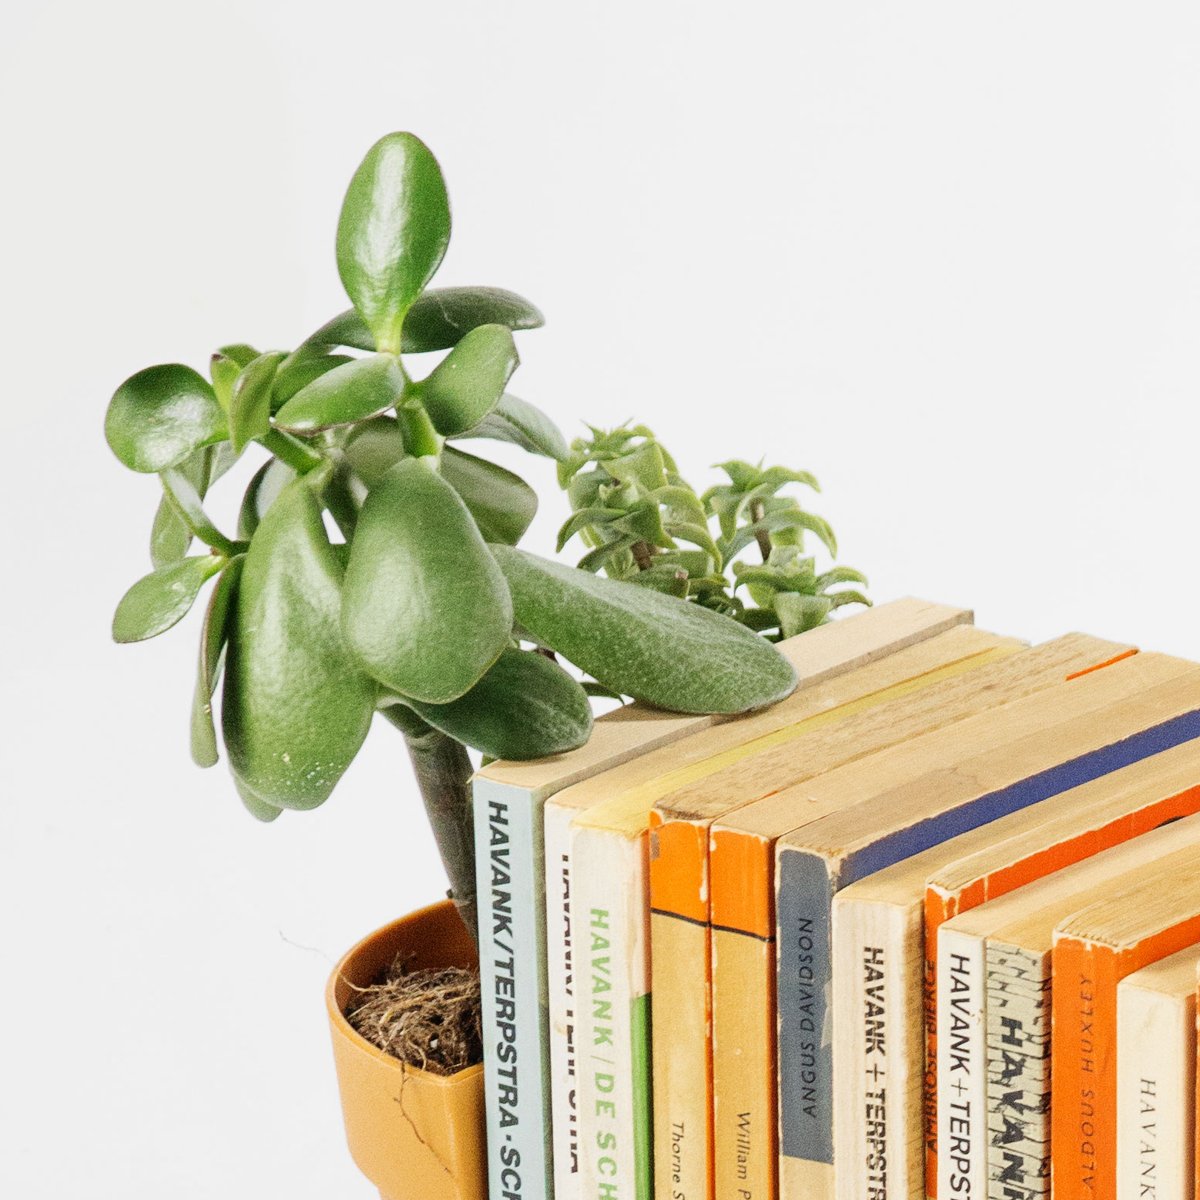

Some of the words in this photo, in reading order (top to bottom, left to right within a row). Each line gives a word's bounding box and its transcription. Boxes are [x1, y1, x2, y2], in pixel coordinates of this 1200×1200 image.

[798, 917, 816, 1032] DAVIDSON
[863, 946, 887, 1057] HAVANK
[950, 953, 971, 1076] HAVANK
[1080, 974, 1095, 1073] HUXLEY
[799, 1041, 819, 1119] ANGUS
[671, 1122, 685, 1184] Thorne
[735, 1112, 752, 1181] William
[1080, 1089, 1095, 1189] ALDOUS
